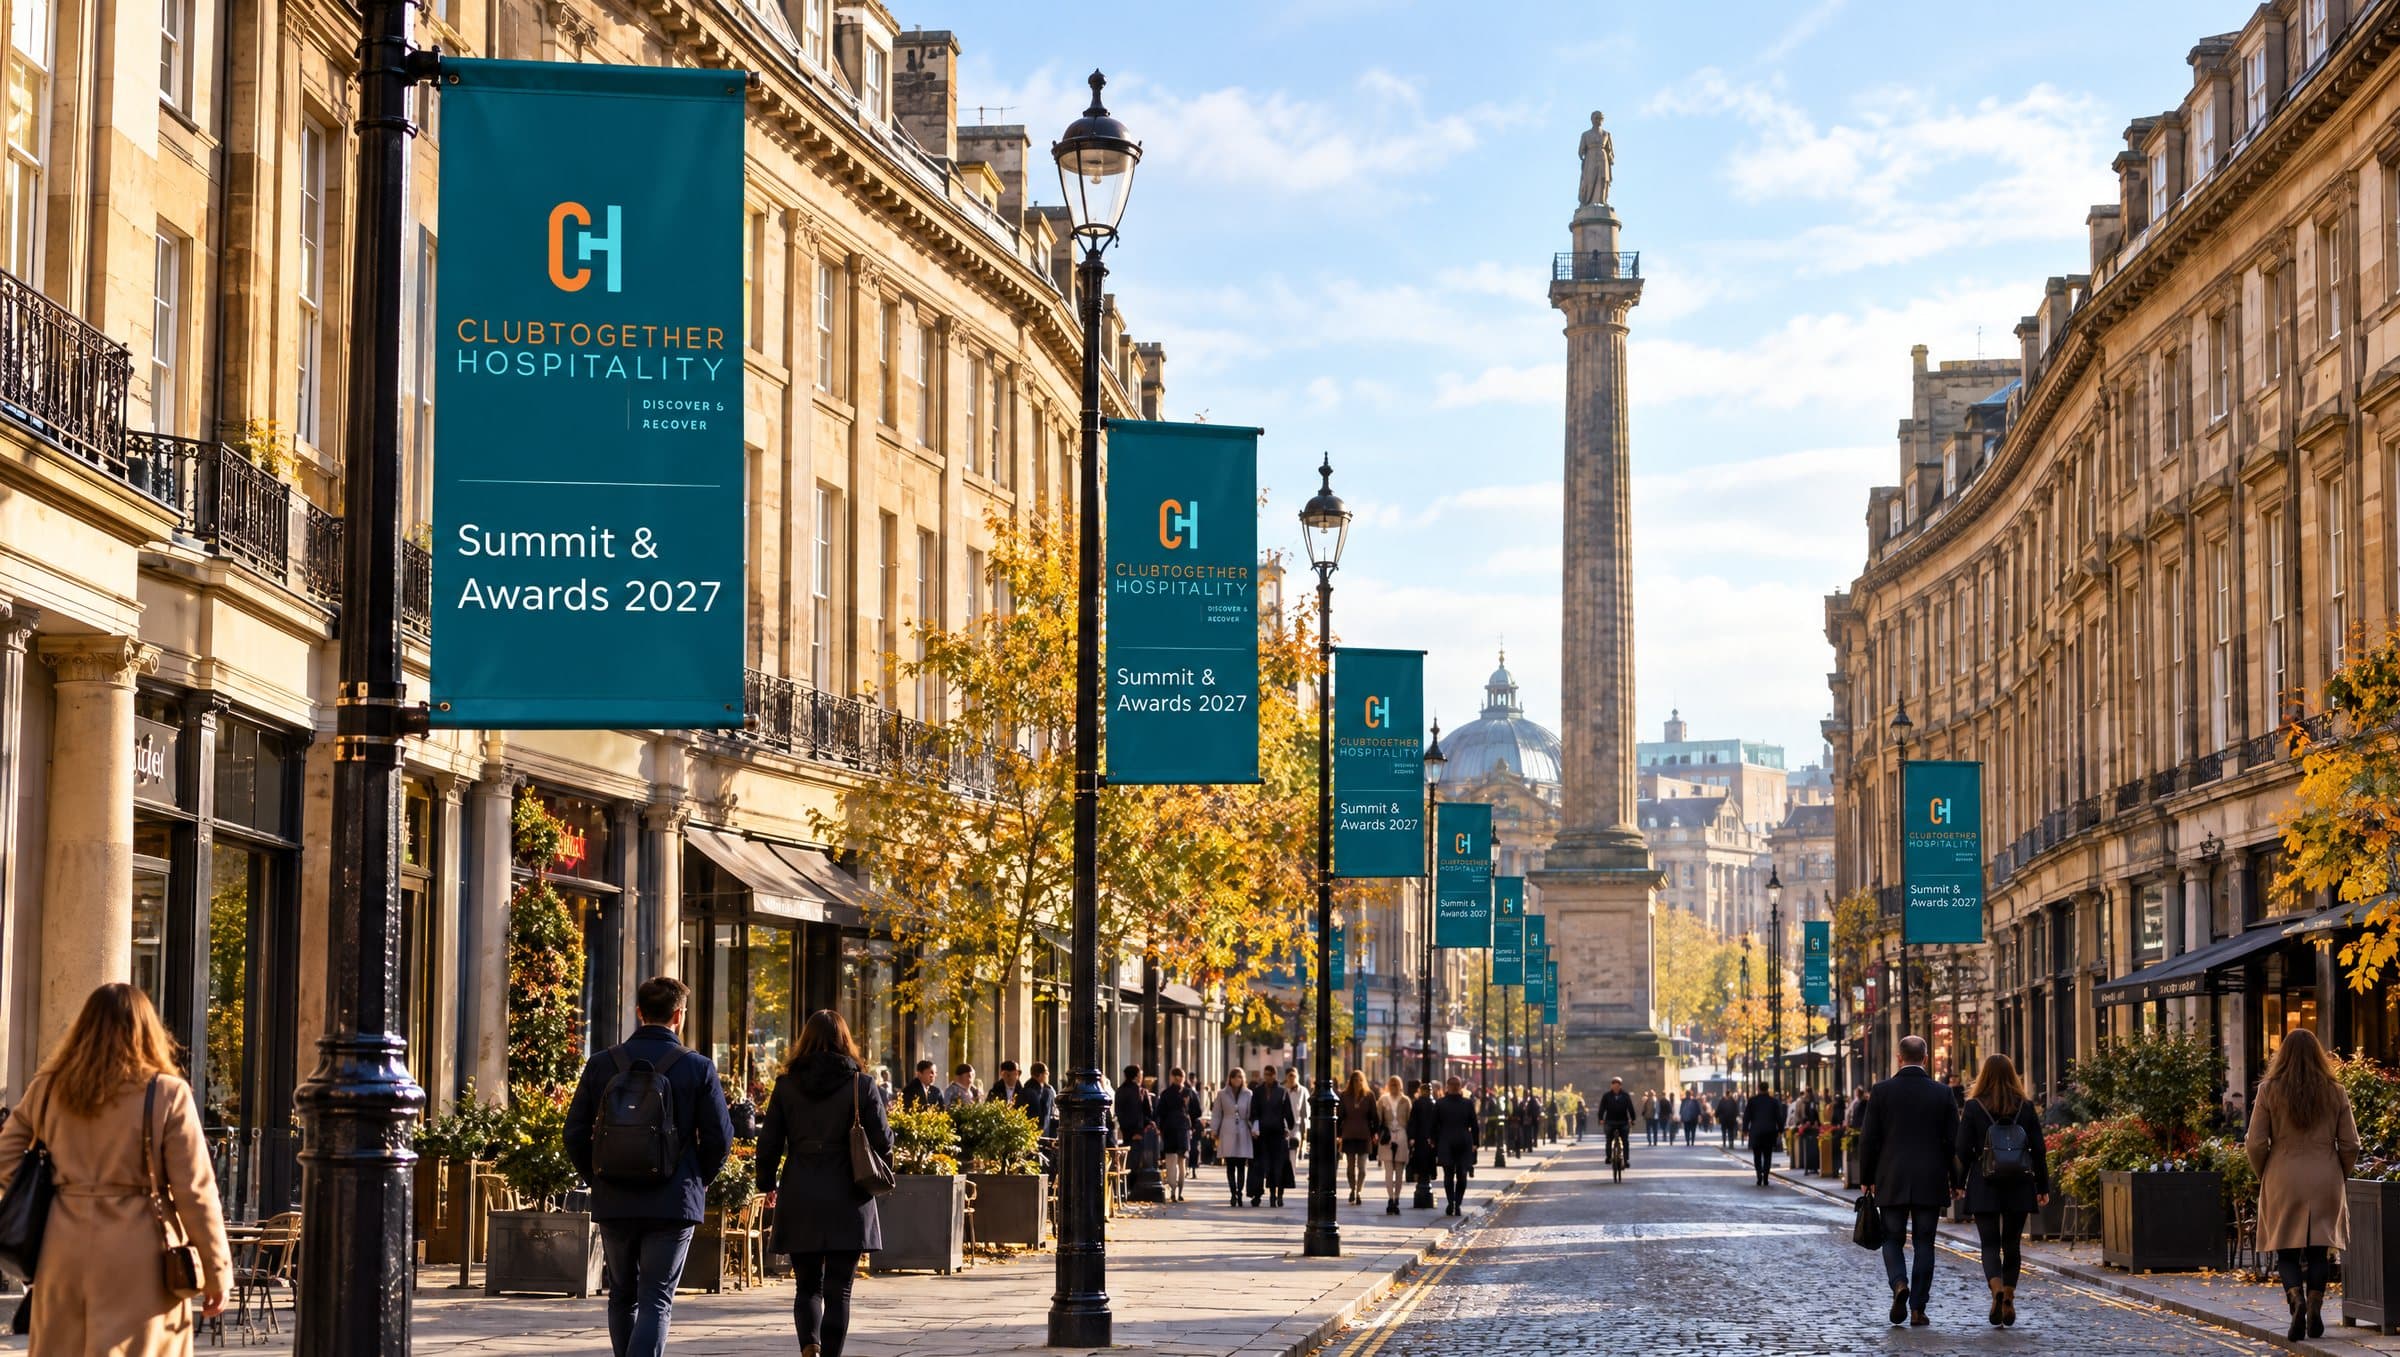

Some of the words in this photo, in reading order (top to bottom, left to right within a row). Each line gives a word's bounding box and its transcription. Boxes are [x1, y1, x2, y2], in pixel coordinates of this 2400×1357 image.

[457, 317, 725, 350] CLUBTOGETHER
[457, 350, 724, 381] HOSPITALITY
[643, 400, 710, 411] DISCOVER
[643, 419, 707, 430] RECOVER
[457, 523, 617, 559] Summit
[630, 528, 659, 560] &
[1116, 563, 1248, 579] CLUBTOGETHER
[1116, 580, 1247, 597] HOSPITALITY
[457, 577, 610, 612] Awards
[623, 581, 722, 613] 2027
[1117, 667, 1195, 686] Summit
[1200, 669, 1216, 686] &
[1117, 693, 1193, 712] Awards
[1199, 694, 1248, 712] 2027
[1340, 737, 1419, 748] CLUBTOGETHER
[1340, 748, 1418, 758] HOSPITALITY
[1340, 803, 1387, 814] Summit
[1391, 803, 1400, 814] &
[1340, 819, 1386, 831] Awards
[1389, 819, 1418, 831] 2027
[1911, 884, 1949, 894] Summit
[1952, 884, 1961, 894] &
[1440, 899, 1469, 908] Summit
[1911, 897, 1949, 907] Awards
[1952, 897, 1976, 907] 2027
[1440, 910, 1469, 918] Awards
[1470, 910, 1487, 918] 2027
